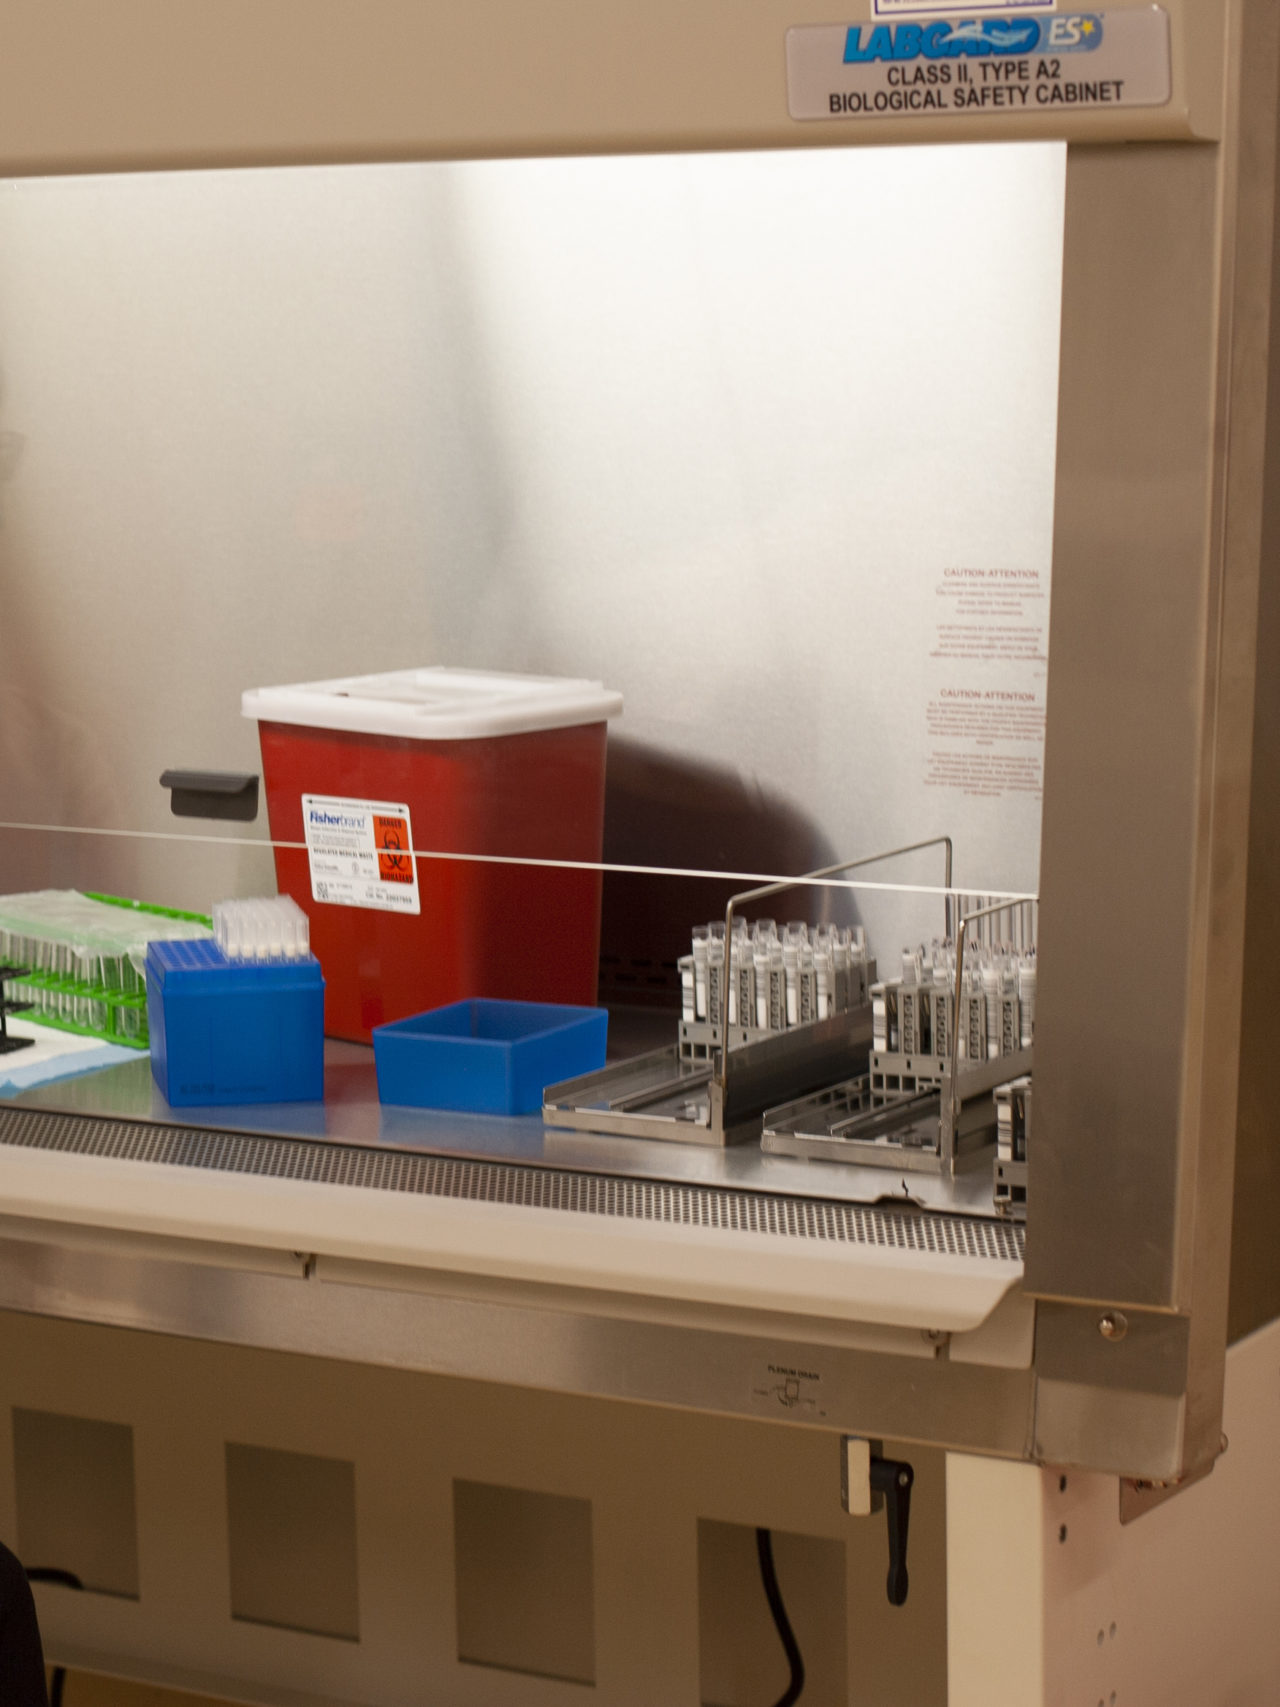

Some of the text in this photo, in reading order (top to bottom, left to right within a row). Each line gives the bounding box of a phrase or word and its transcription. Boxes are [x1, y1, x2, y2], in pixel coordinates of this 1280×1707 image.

[1049, 17, 1081, 46] ES
[887, 59, 1061, 86] CLASS II, TYPE A2
[829, 80, 1124, 113] BIOLOGICAL SAFETY CABINET
[943, 568, 1039, 579] CAUTION ATTENTION
[940, 688, 1035, 702] CAUTION ATTENTION
[310, 811, 365, 827] Fisherbrand
